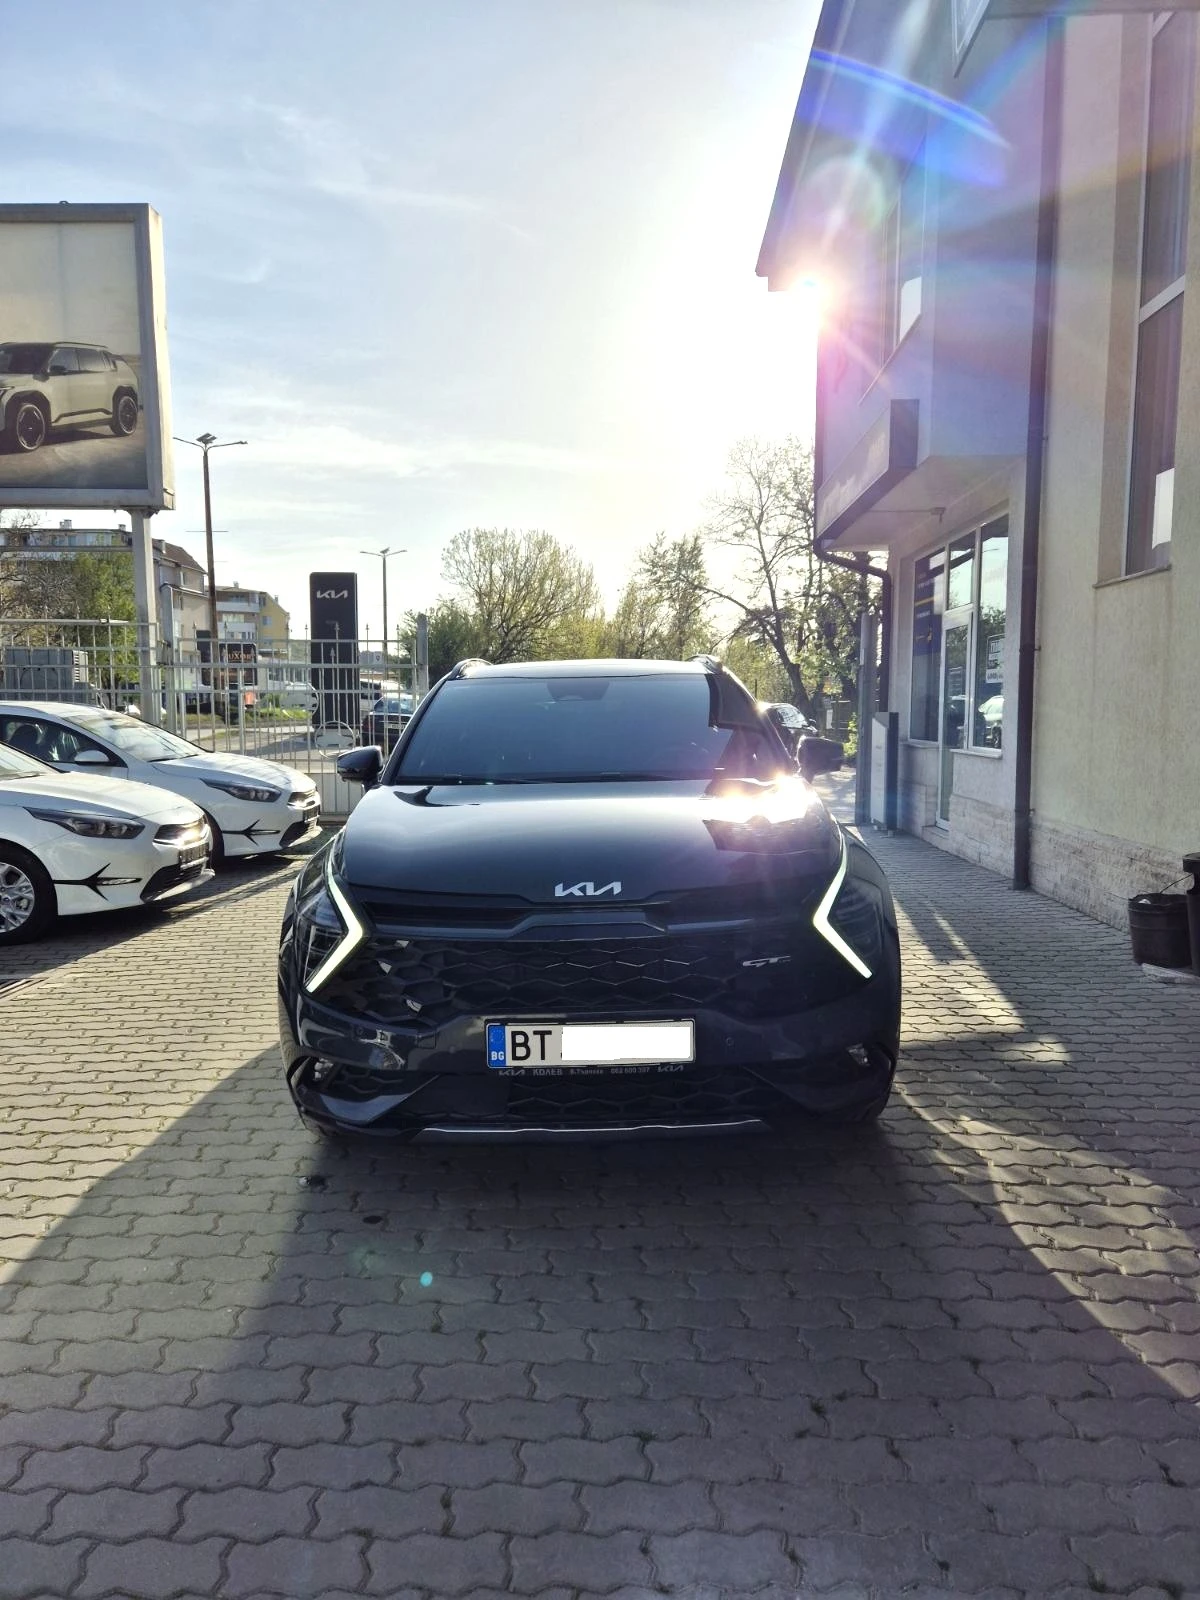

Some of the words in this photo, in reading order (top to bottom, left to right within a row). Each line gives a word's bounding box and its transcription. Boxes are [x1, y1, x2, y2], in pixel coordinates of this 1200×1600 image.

[316, 589, 349, 599] KIA
[554, 881, 622, 897] KIA
[510, 1030, 553, 1061] BT
[490, 1051, 505, 1061] BG
